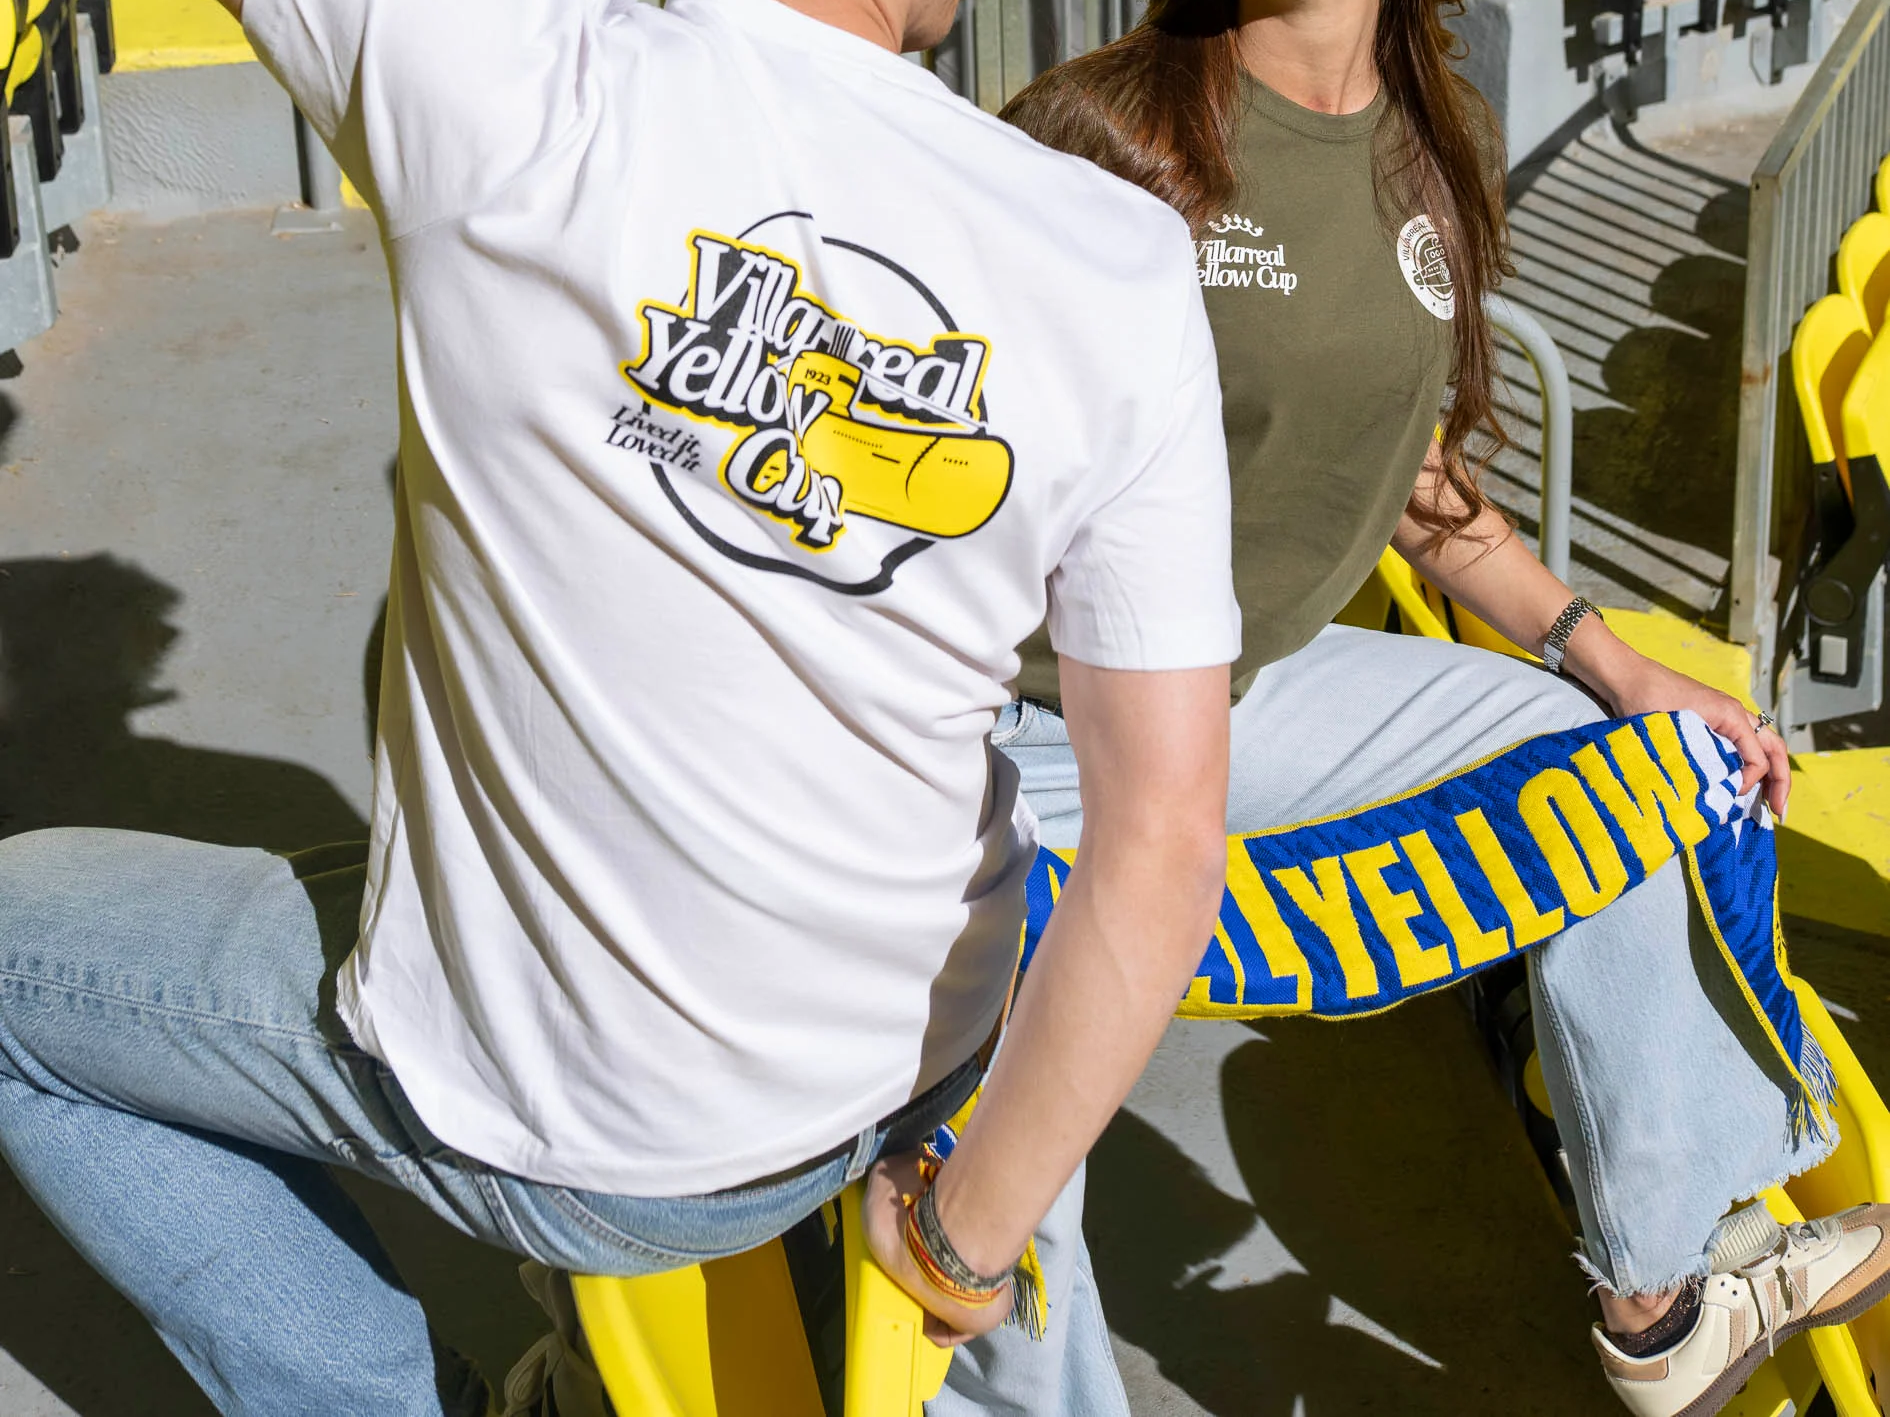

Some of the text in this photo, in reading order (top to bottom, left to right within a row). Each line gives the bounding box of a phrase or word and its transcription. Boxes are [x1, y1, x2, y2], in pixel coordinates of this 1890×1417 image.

[1196, 262, 1298, 296] ellow Cup
[626, 308, 832, 444] Yellow
[805, 368, 832, 386] 1923
[605, 423, 681, 463] Loved
[610, 404, 682, 444] Lived
[727, 427, 843, 545] Cup
[1270, 711, 1711, 1000] YELLOW
